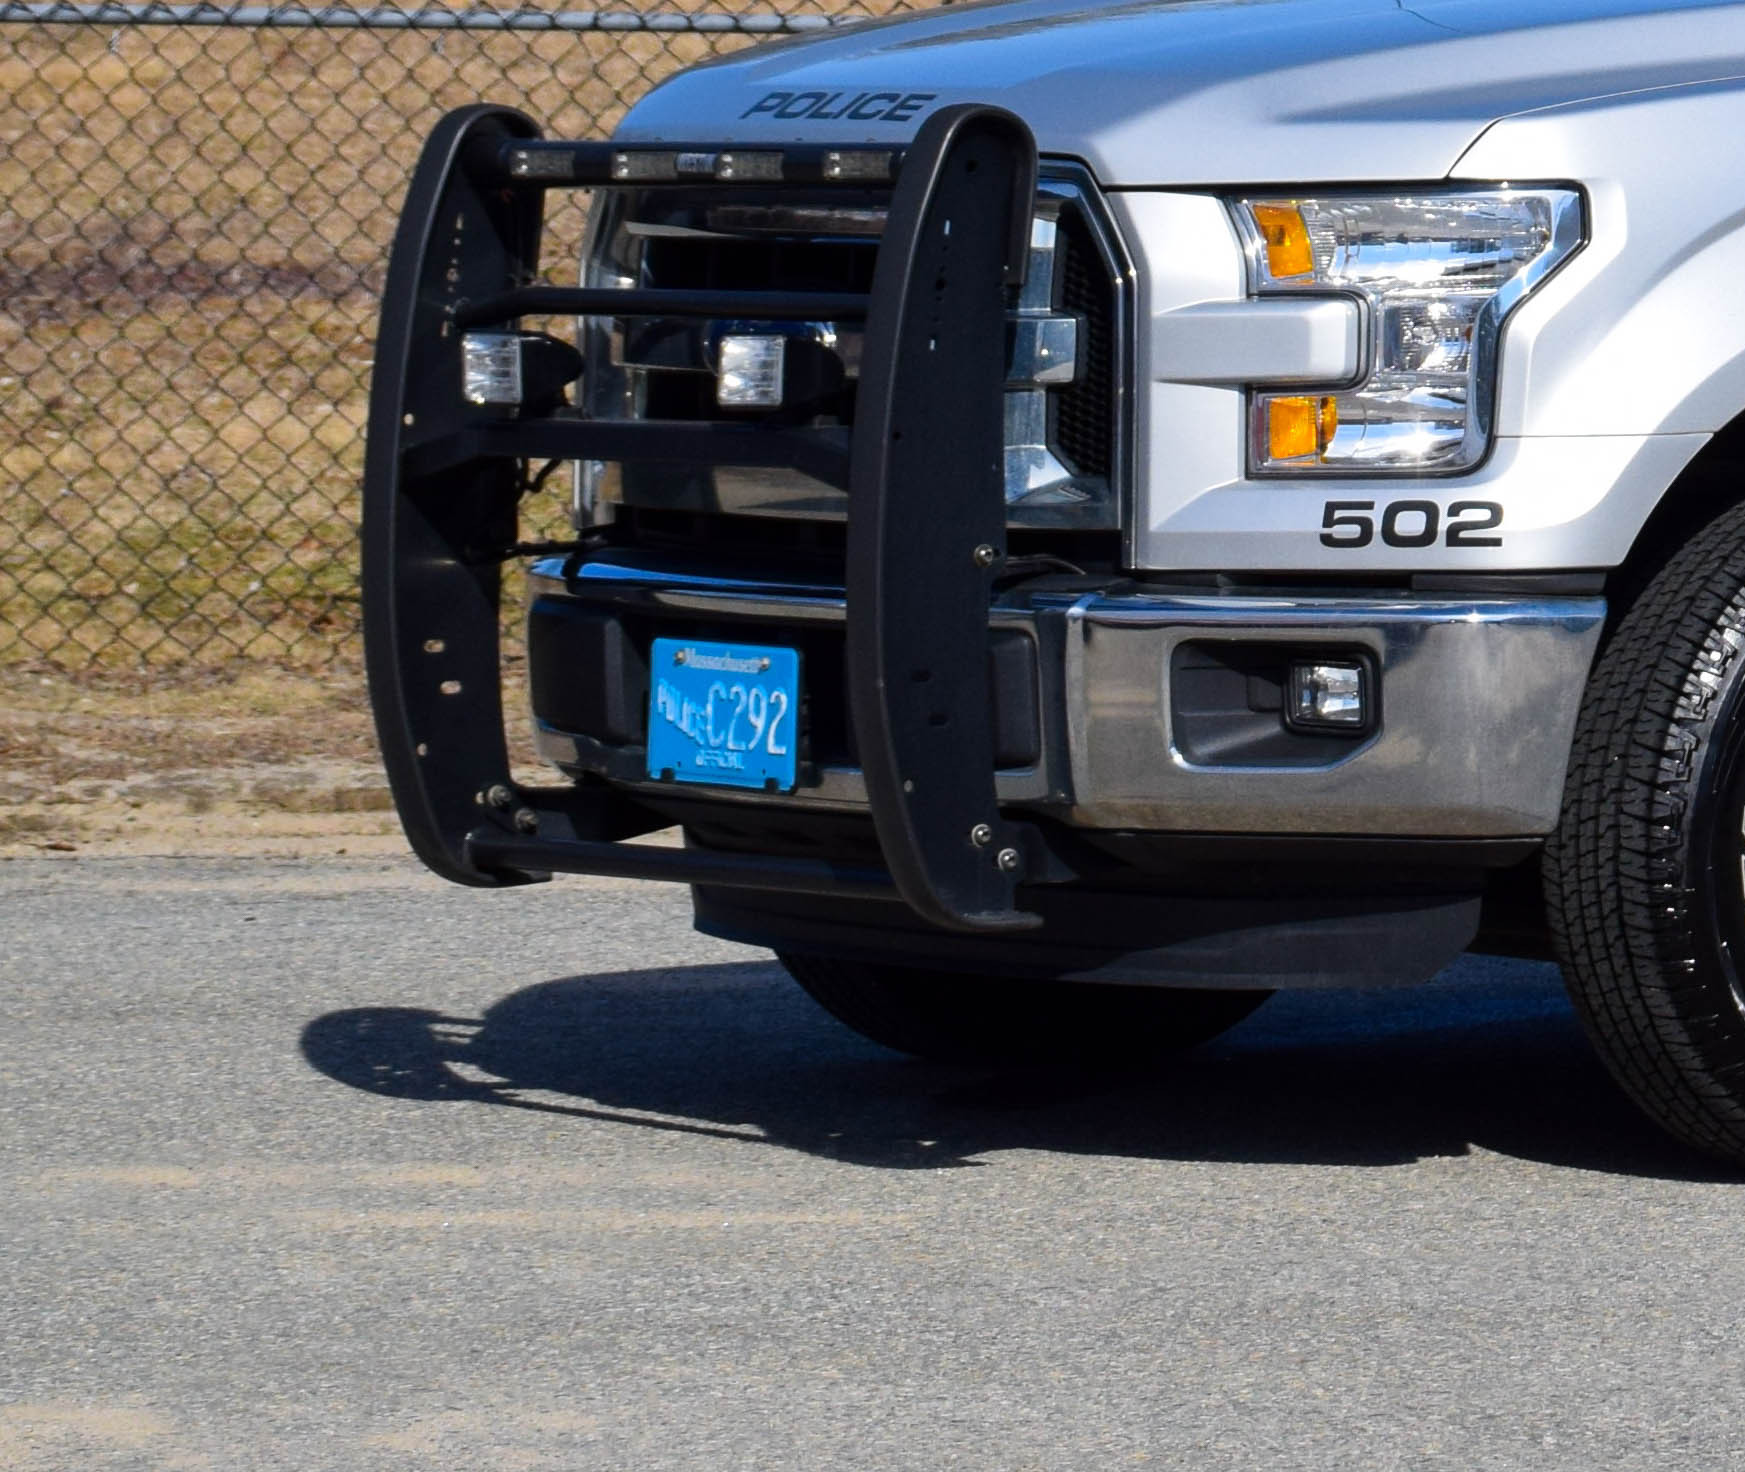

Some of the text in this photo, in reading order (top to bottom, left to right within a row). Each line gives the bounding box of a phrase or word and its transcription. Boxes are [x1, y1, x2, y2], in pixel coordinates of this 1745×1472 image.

[739, 92, 936, 122] POLICE
[1319, 499, 1505, 549] 502
[706, 680, 788, 755] C292
